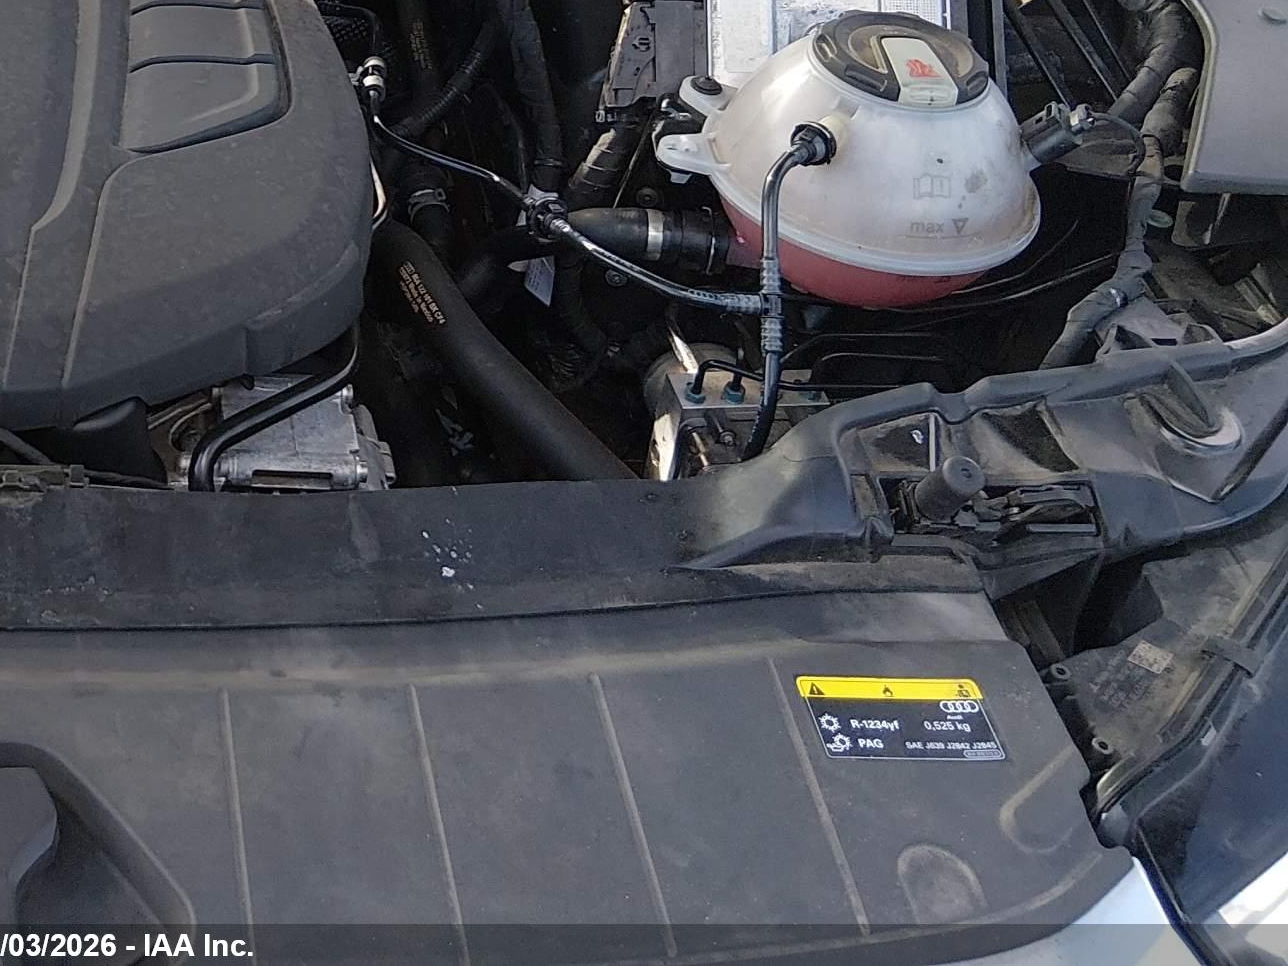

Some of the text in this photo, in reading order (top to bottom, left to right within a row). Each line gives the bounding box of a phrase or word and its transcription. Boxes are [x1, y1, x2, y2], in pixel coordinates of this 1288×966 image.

[910, 221, 945, 234] max
[850, 718, 900, 732] R-1234yf
[923, 721, 971, 732] 0,525 kg
[857, 738, 884, 749] PAG
[905, 742, 924, 750] SAE
